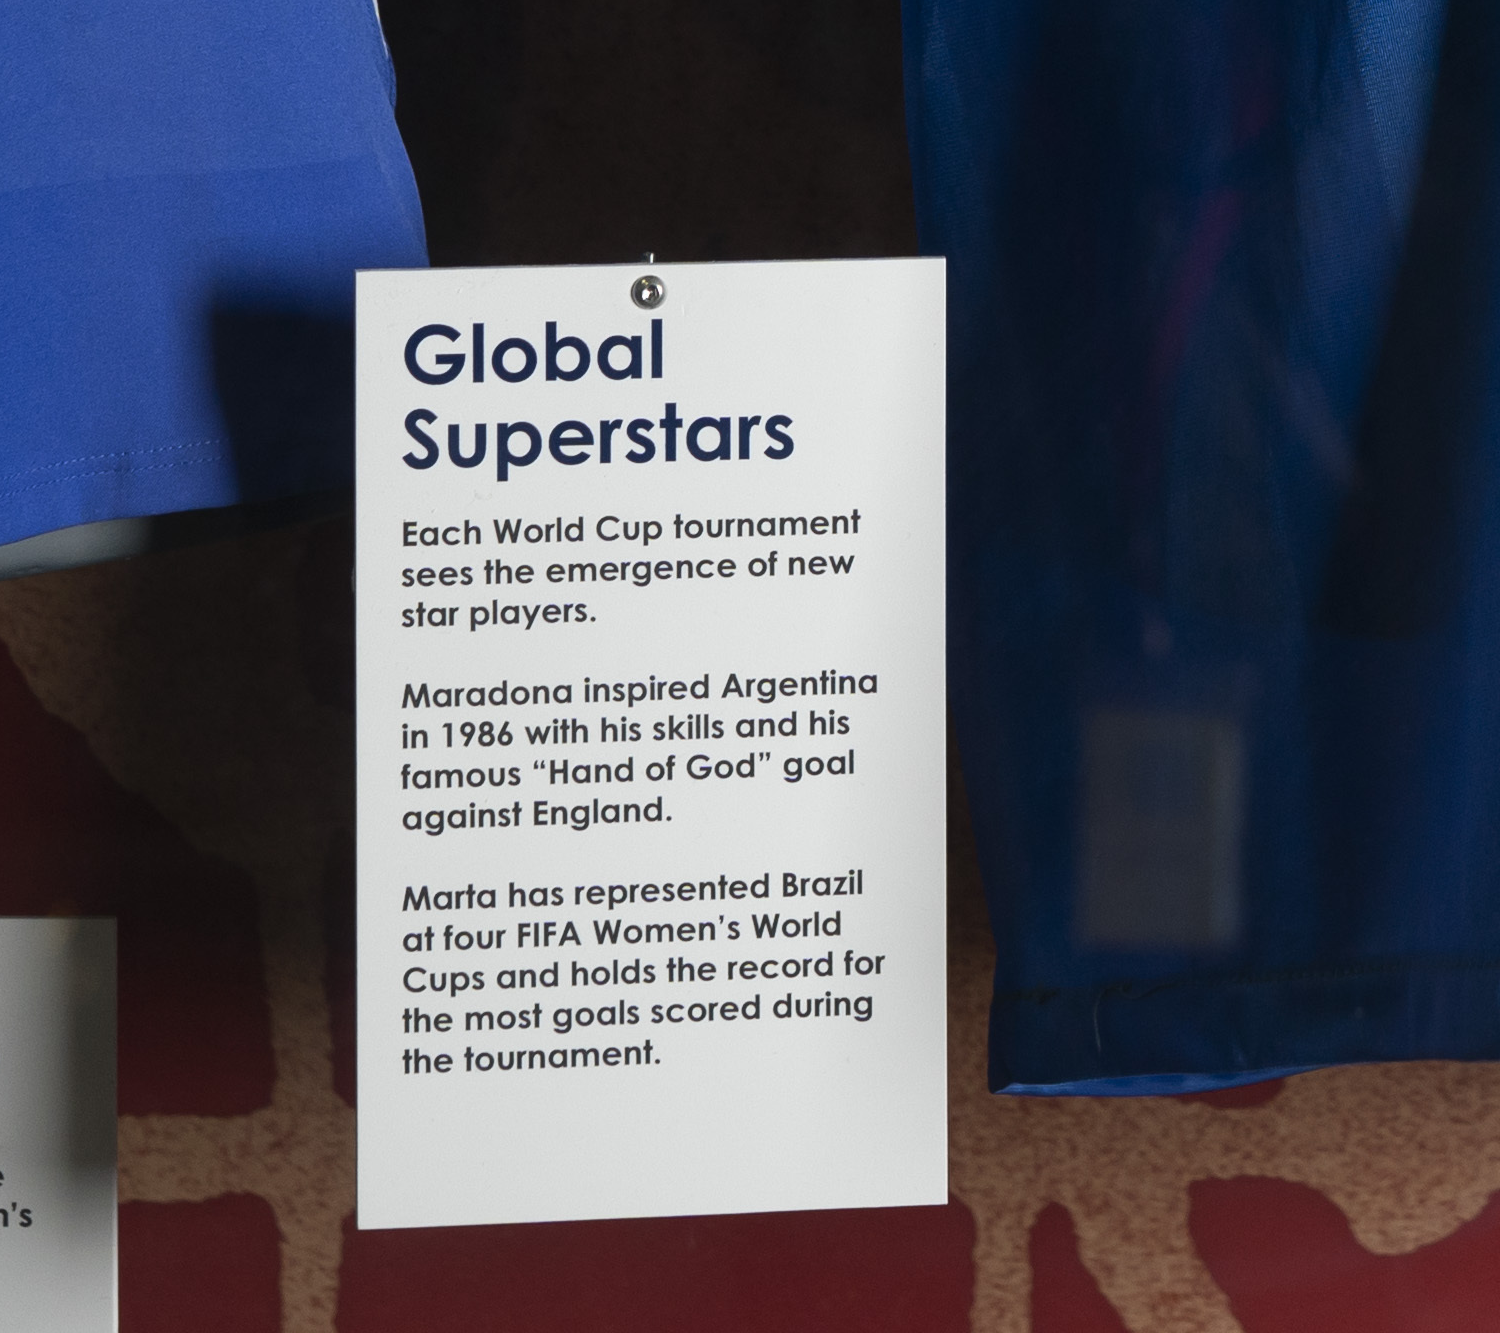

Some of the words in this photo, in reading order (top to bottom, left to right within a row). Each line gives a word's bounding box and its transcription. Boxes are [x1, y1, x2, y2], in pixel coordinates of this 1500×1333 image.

[404, 319, 662, 385] Global
[402, 403, 794, 482] Superstars
[403, 520, 481, 546] Each
[493, 516, 583, 544] World
[596, 516, 662, 546] Cup
[674, 509, 861, 538] tournament
[402, 567, 473, 587] sees
[484, 559, 534, 584] the
[546, 559, 736, 587] emergence
[748, 551, 778, 577] of
[789, 555, 855, 575] new
[402, 602, 459, 627] star
[471, 600, 596, 631] players.
[402, 680, 572, 708] Maradona
[584, 674, 709, 707] inspired
[721, 669, 877, 703] Argentina
[402, 723, 428, 749] in
[443, 721, 513, 747] 1986
[525, 718, 588, 744] with
[601, 716, 641, 742] his
[653, 714, 724, 741] skills
[736, 711, 797, 738] and
[810, 709, 850, 735] his
[401, 764, 521, 789] famous
[534, 757, 633, 784] “Hand
[646, 755, 675, 781] of
[687, 752, 770, 780] God”
[784, 749, 854, 783] goal
[403, 802, 522, 836] against
[534, 796, 672, 831] England.
[402, 884, 496, 911] Marta
[509, 882, 563, 907] has
[575, 873, 769, 910] represented
[783, 869, 862, 897] Brazil
[403, 926, 434, 952] at
[443, 925, 506, 950] four
[518, 921, 581, 948] FIFA
[593, 915, 740, 944] Women’s
[752, 911, 841, 938] World
[403, 967, 485, 997] Cups
[497, 962, 558, 989] and
[572, 959, 655, 986] holds
[666, 957, 716, 982] the
[728, 951, 833, 980] record
[844, 950, 885, 975] for
[402, 1008, 453, 1033] the
[466, 1003, 542, 1031] most
[553, 1000, 639, 1034] goals
[651, 994, 760, 1023] scored
[773, 991, 872, 1022] during
[402, 1048, 453, 1074] the
[464, 1040, 660, 1071] tournament.
